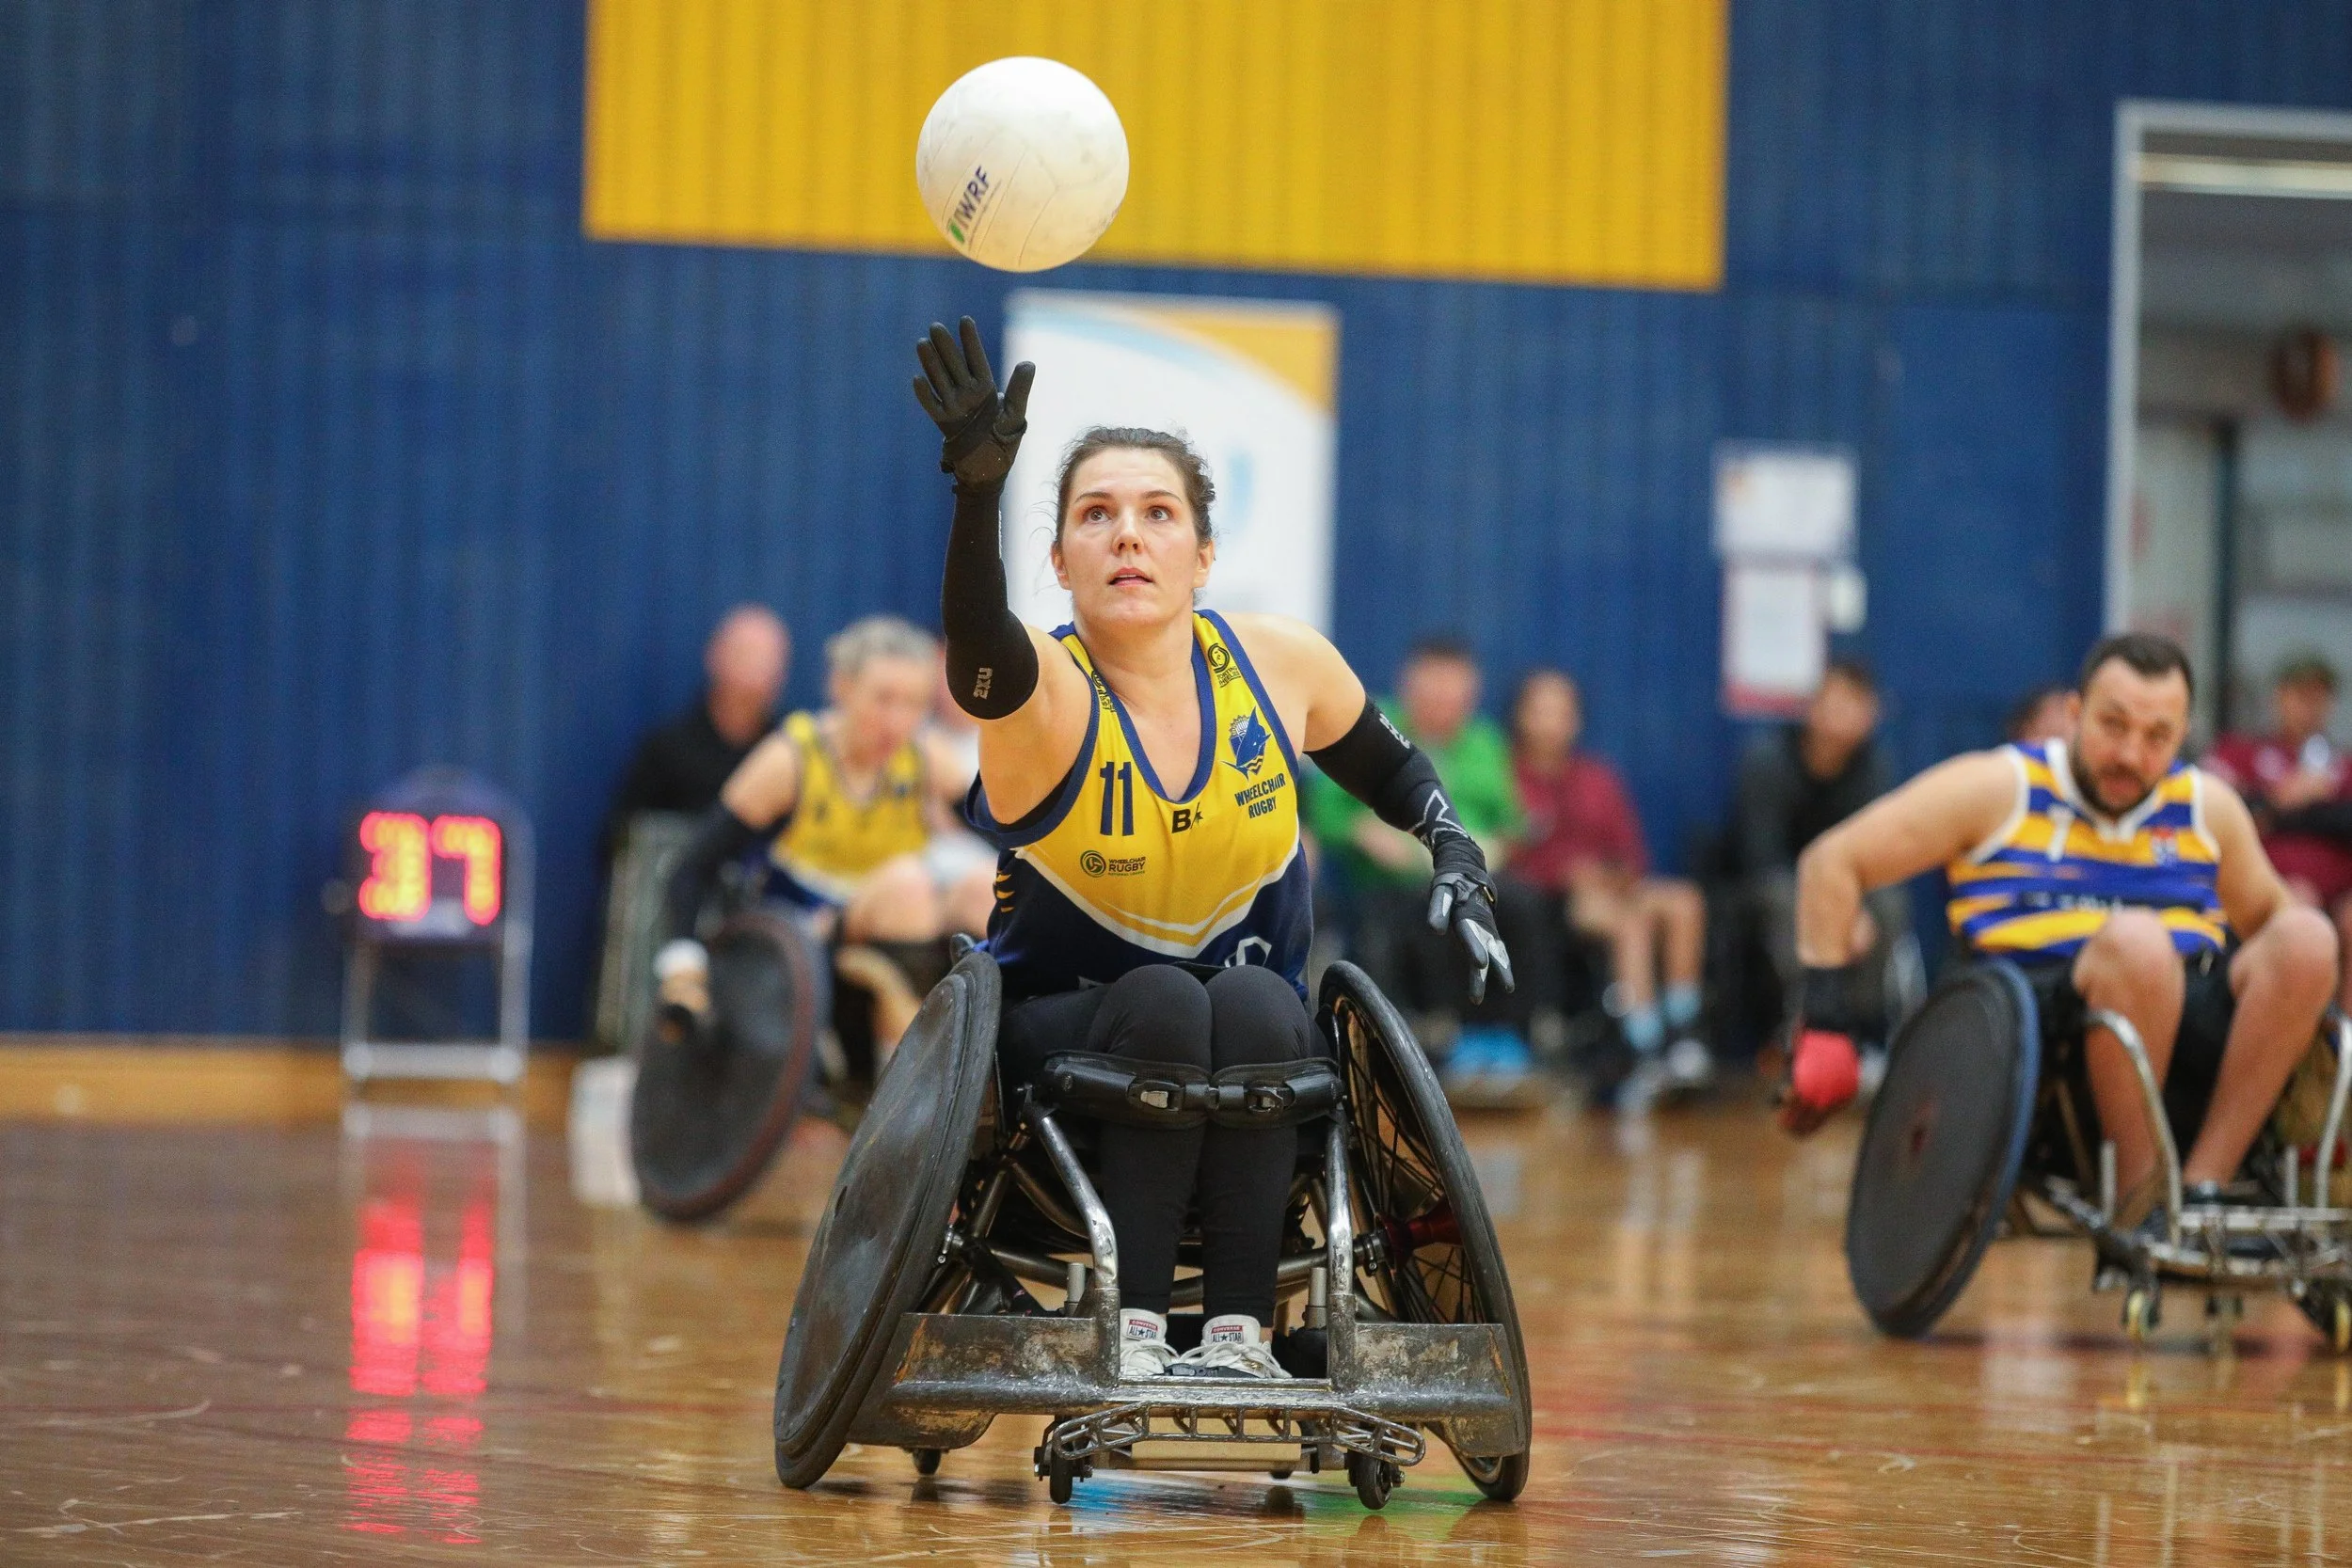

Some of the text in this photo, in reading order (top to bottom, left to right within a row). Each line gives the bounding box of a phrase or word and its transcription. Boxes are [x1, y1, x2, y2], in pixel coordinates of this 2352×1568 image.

[953, 166, 989, 230] IWRF
[973, 667, 993, 700] 2XU
[1100, 761, 1135, 836] 11
[1234, 772, 1286, 807] WHEELCHAIR
[1248, 796, 1277, 818] RUGBY
[358, 809, 502, 926] 37
[1108, 862, 1145, 872] RUGBY
[1129, 1325, 1138, 1337] ALL
[1212, 1332, 1242, 1343] ALL STAR
